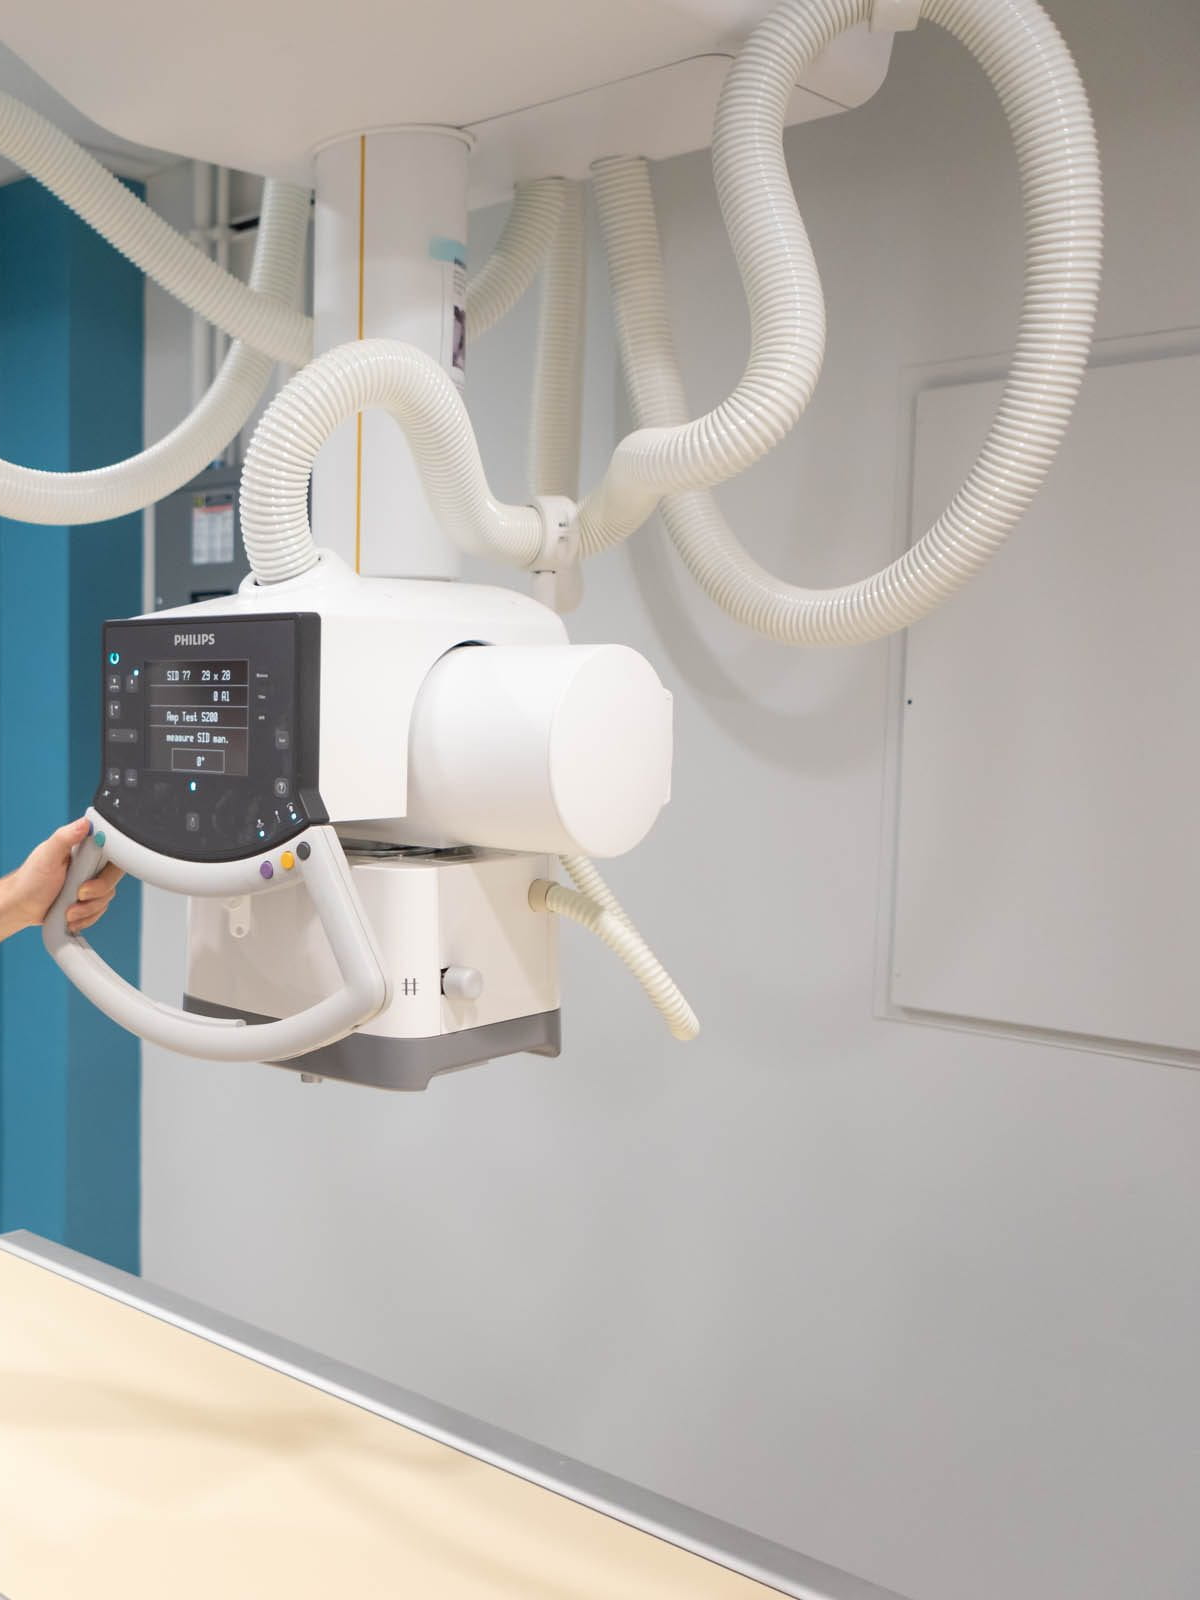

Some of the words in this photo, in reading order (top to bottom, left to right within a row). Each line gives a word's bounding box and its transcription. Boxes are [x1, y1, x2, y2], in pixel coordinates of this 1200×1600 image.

[174, 633, 215, 646] PHILIPS
[166, 670, 179, 681] SID
[201, 670, 211, 681] 29
[221, 670, 231, 681] 28
[182, 711, 198, 722] Test
[166, 734, 194, 743] measure
[197, 732, 210, 743] SID
